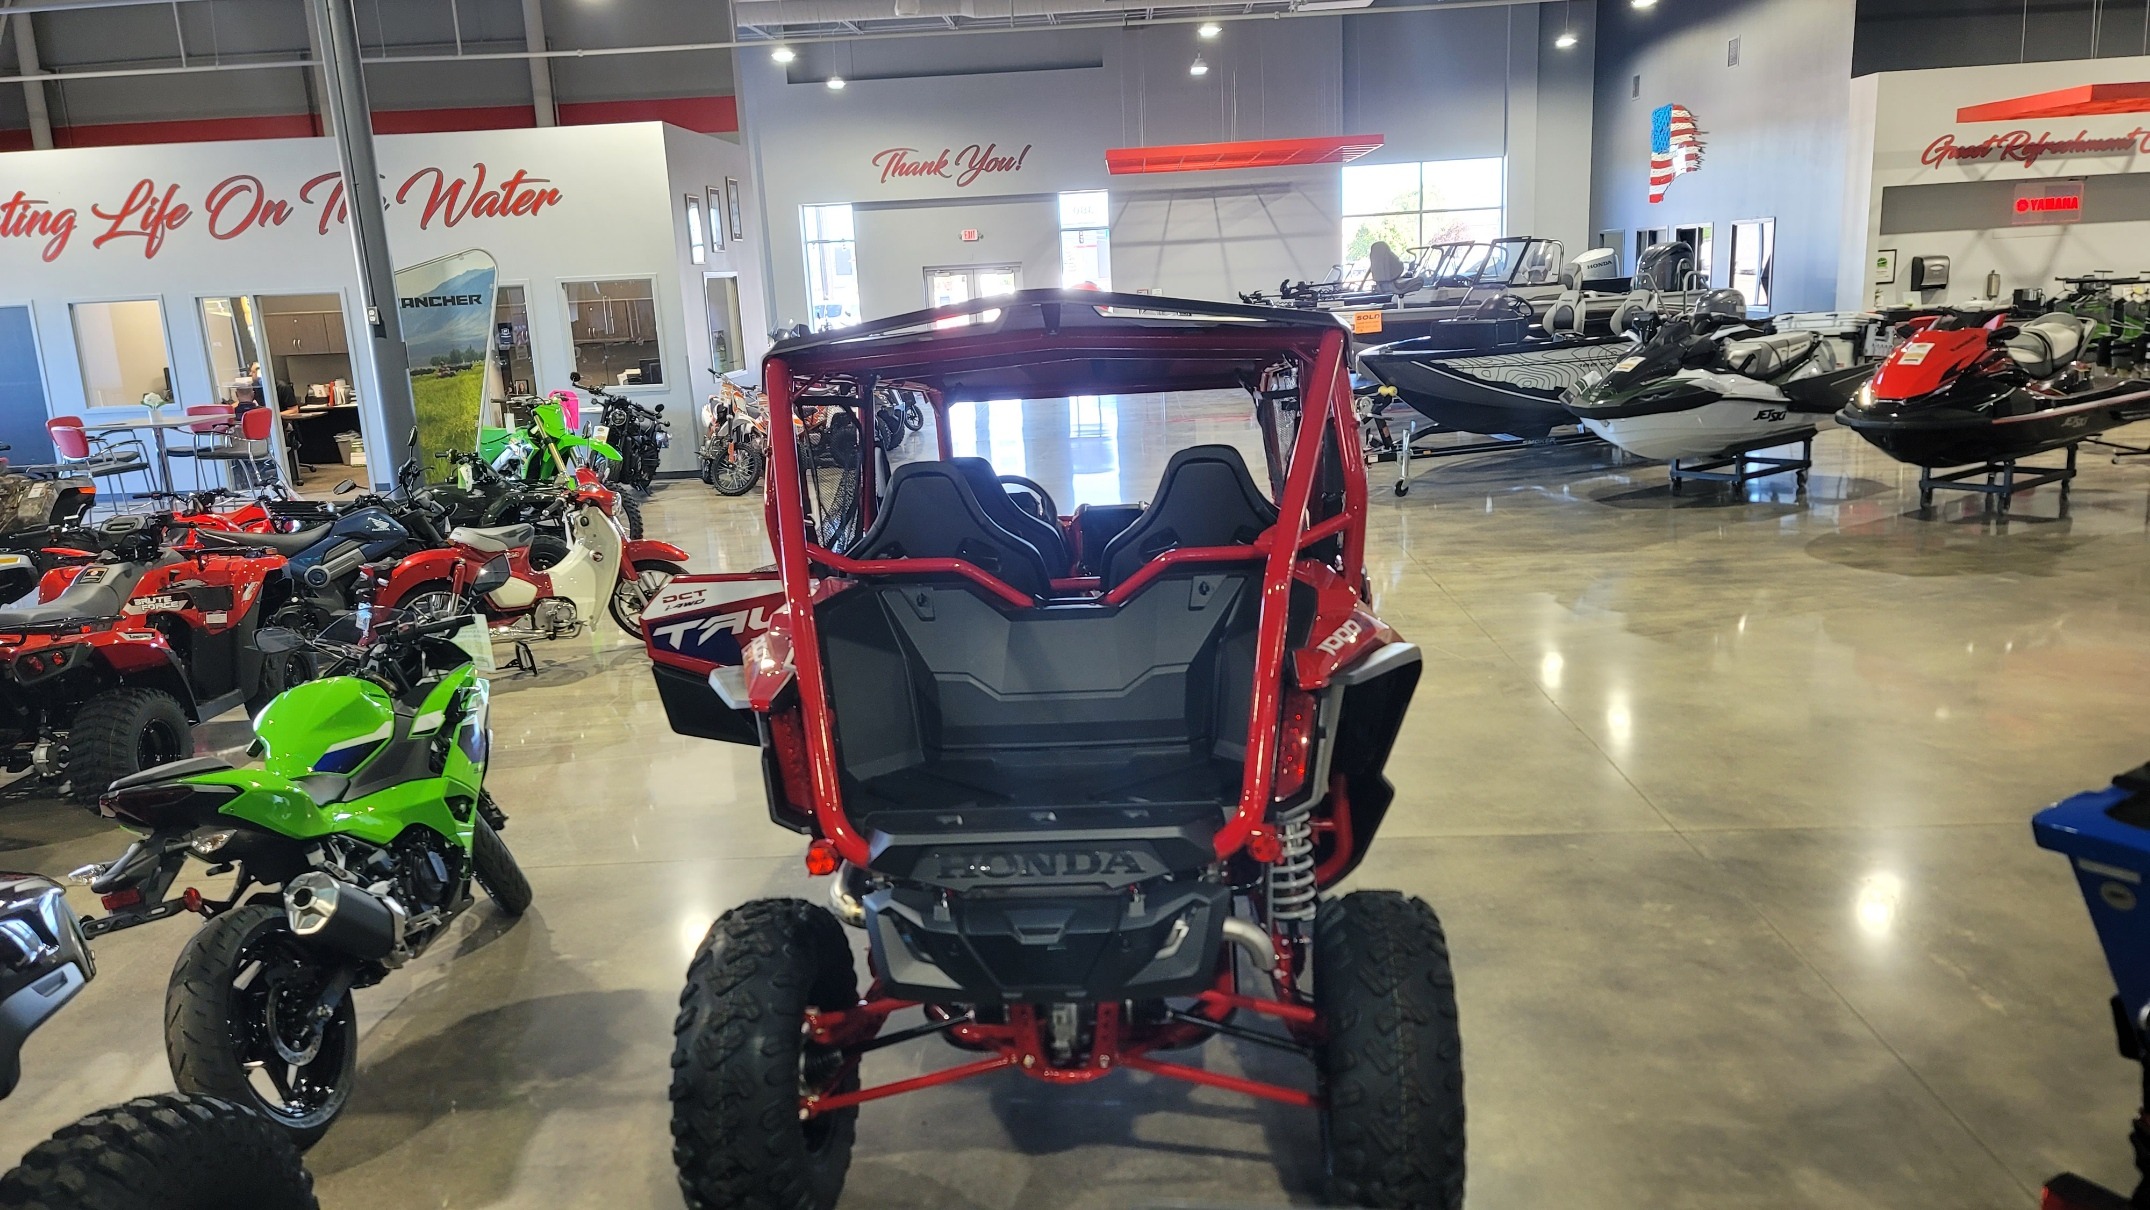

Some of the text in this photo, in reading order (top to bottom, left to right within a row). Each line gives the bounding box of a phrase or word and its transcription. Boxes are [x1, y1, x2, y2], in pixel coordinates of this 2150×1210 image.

[872, 144, 1032, 187] Thank You!
[91, 178, 193, 260] Life
[205, 174, 293, 240] On
[395, 162, 563, 230] Water
[2030, 196, 2079, 211] YAMAHA
[1587, 260, 1613, 270] HONDA
[399, 294, 482, 309] ANCHER
[134, 595, 173, 605] BRUTE
[662, 589, 707, 603] DCT
[141, 602, 180, 611] FORCE
[1316, 619, 1363, 657] 1000
[937, 850, 1147, 878] HONDA
